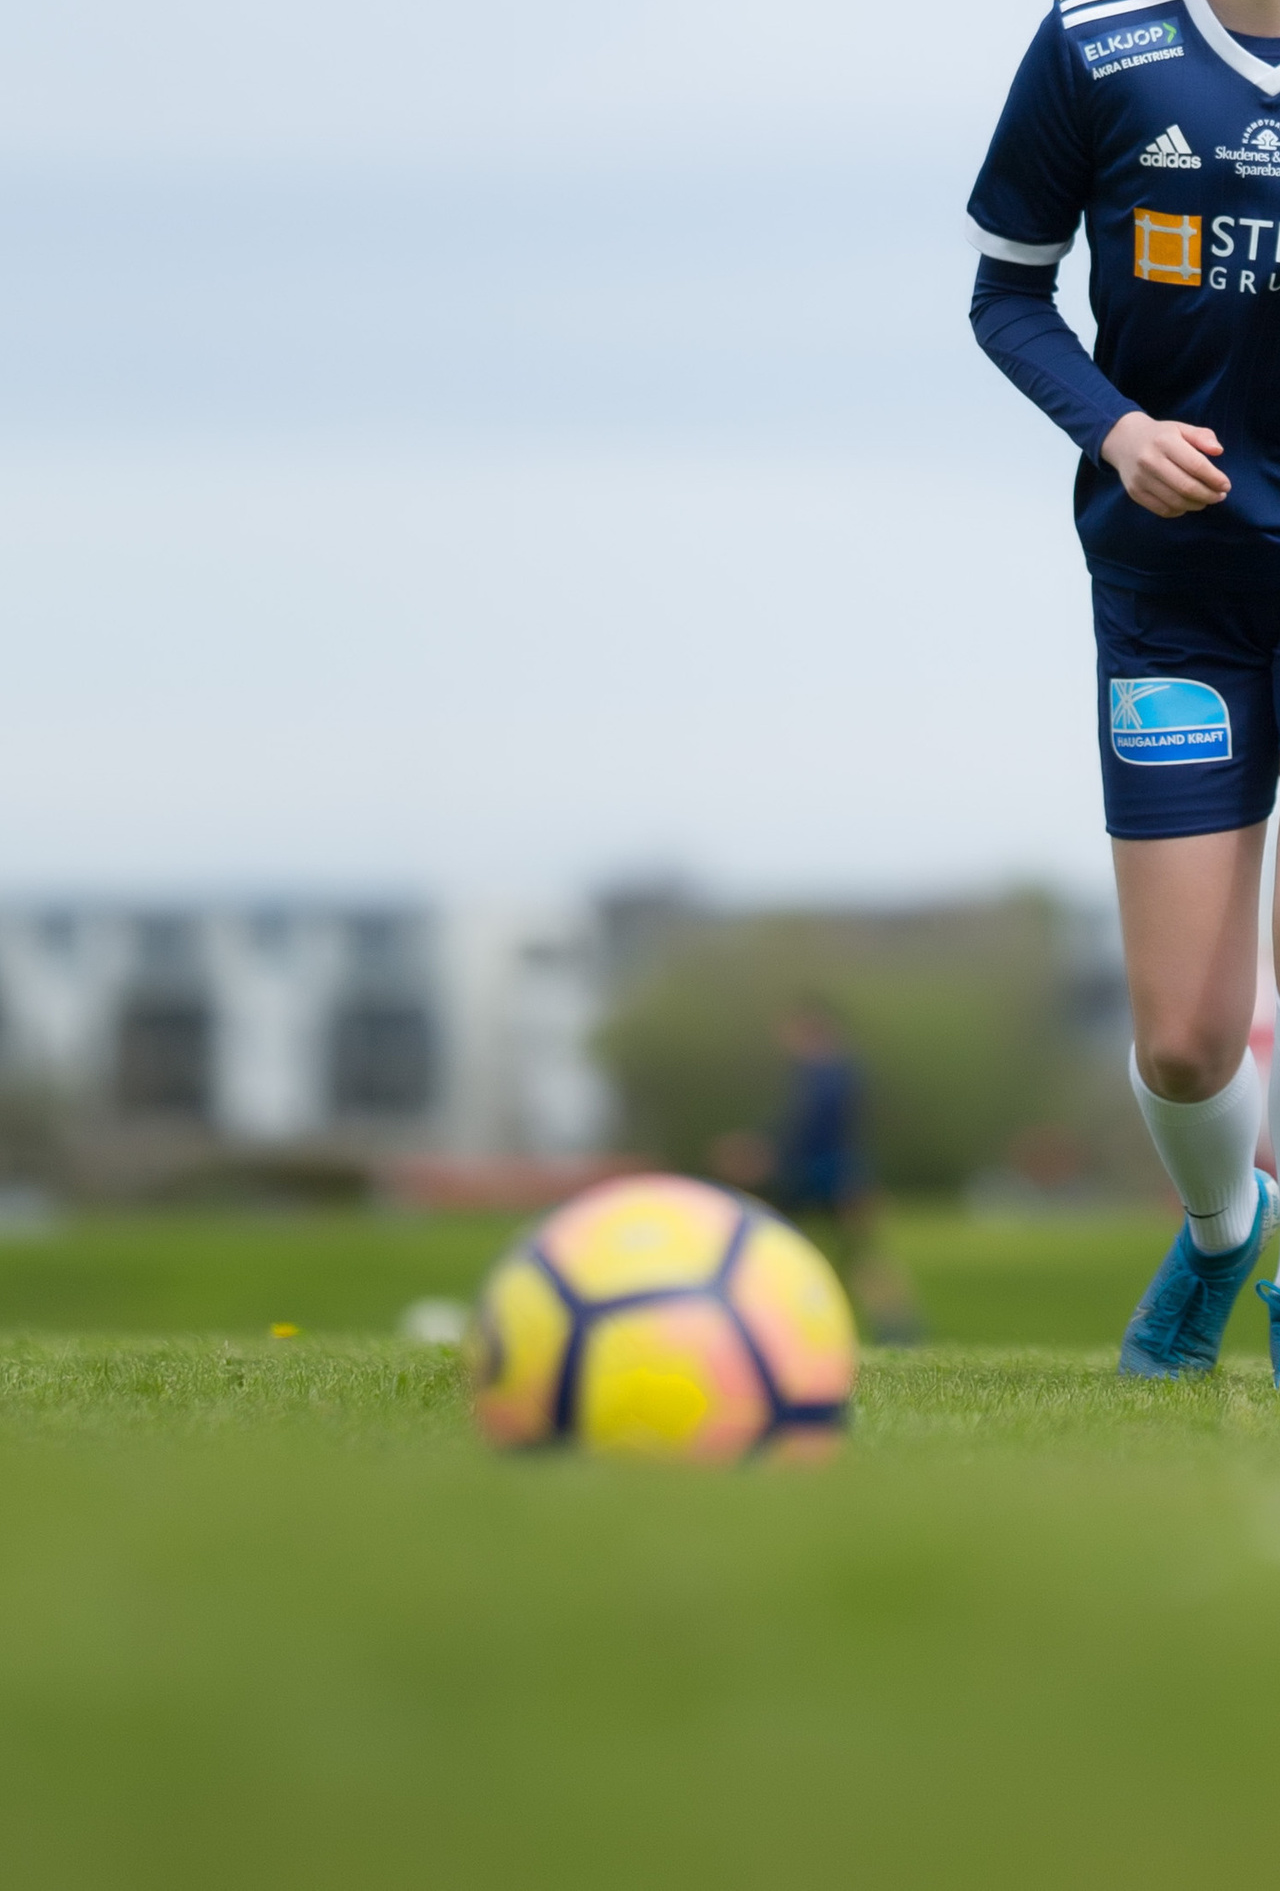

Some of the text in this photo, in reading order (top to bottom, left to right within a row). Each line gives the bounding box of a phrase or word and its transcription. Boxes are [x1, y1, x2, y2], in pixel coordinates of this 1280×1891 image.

[1092, 46, 1185, 81] ÅKRA ELEKTRISKE
[1139, 151, 1202, 170] adidas
[1215, 146, 1270, 162] Skudenes
[1117, 730, 1224, 749] HAUGALAND KRAFT
